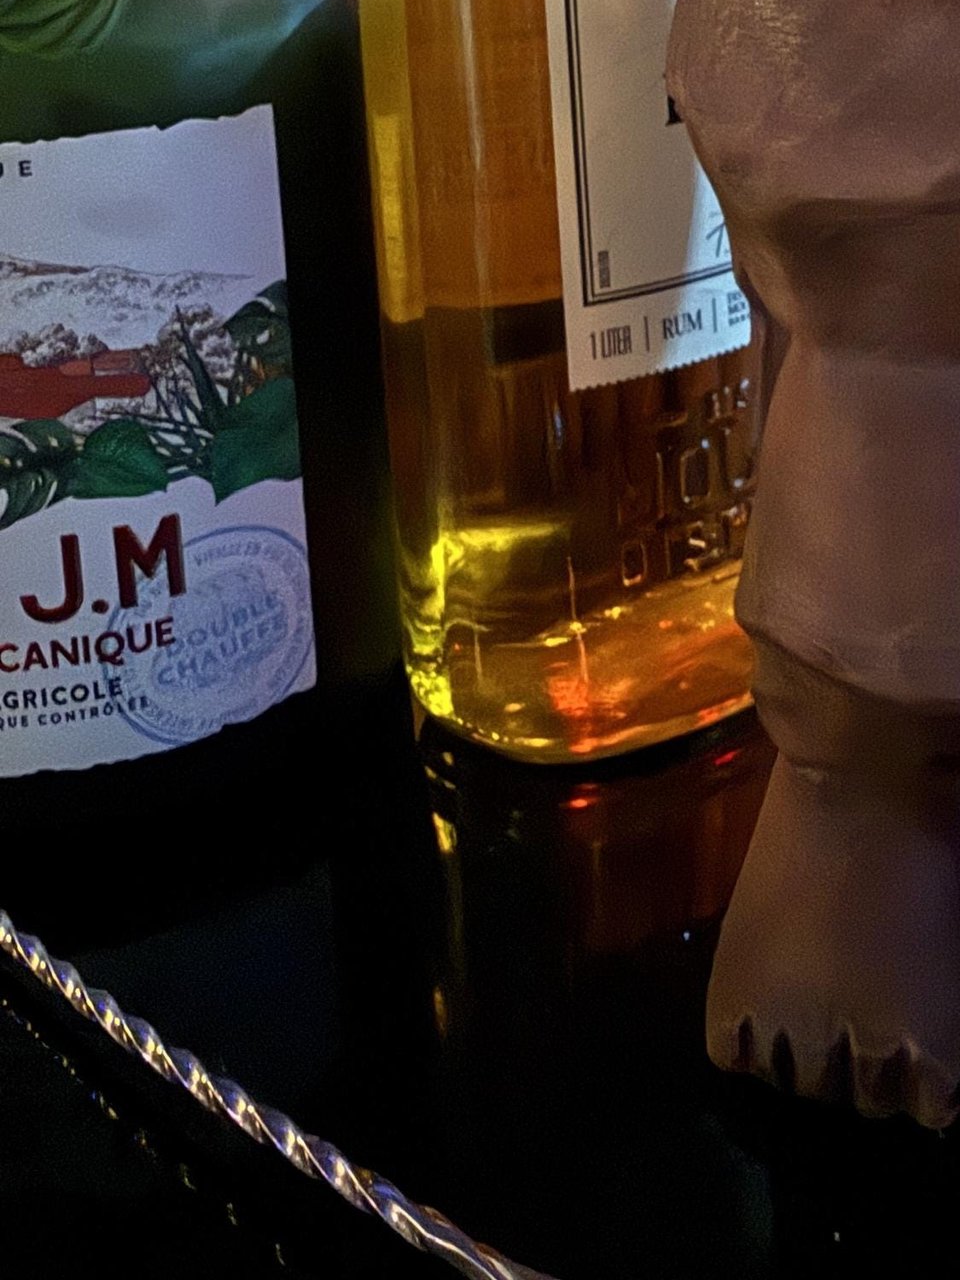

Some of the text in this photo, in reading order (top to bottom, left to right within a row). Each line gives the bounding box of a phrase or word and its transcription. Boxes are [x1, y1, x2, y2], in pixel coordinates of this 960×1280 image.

[601, 324, 633, 359] LITER
[662, 308, 704, 340] RUM
[19, 512, 187, 625] J.M
[0, 676, 123, 712] GRICOLE
